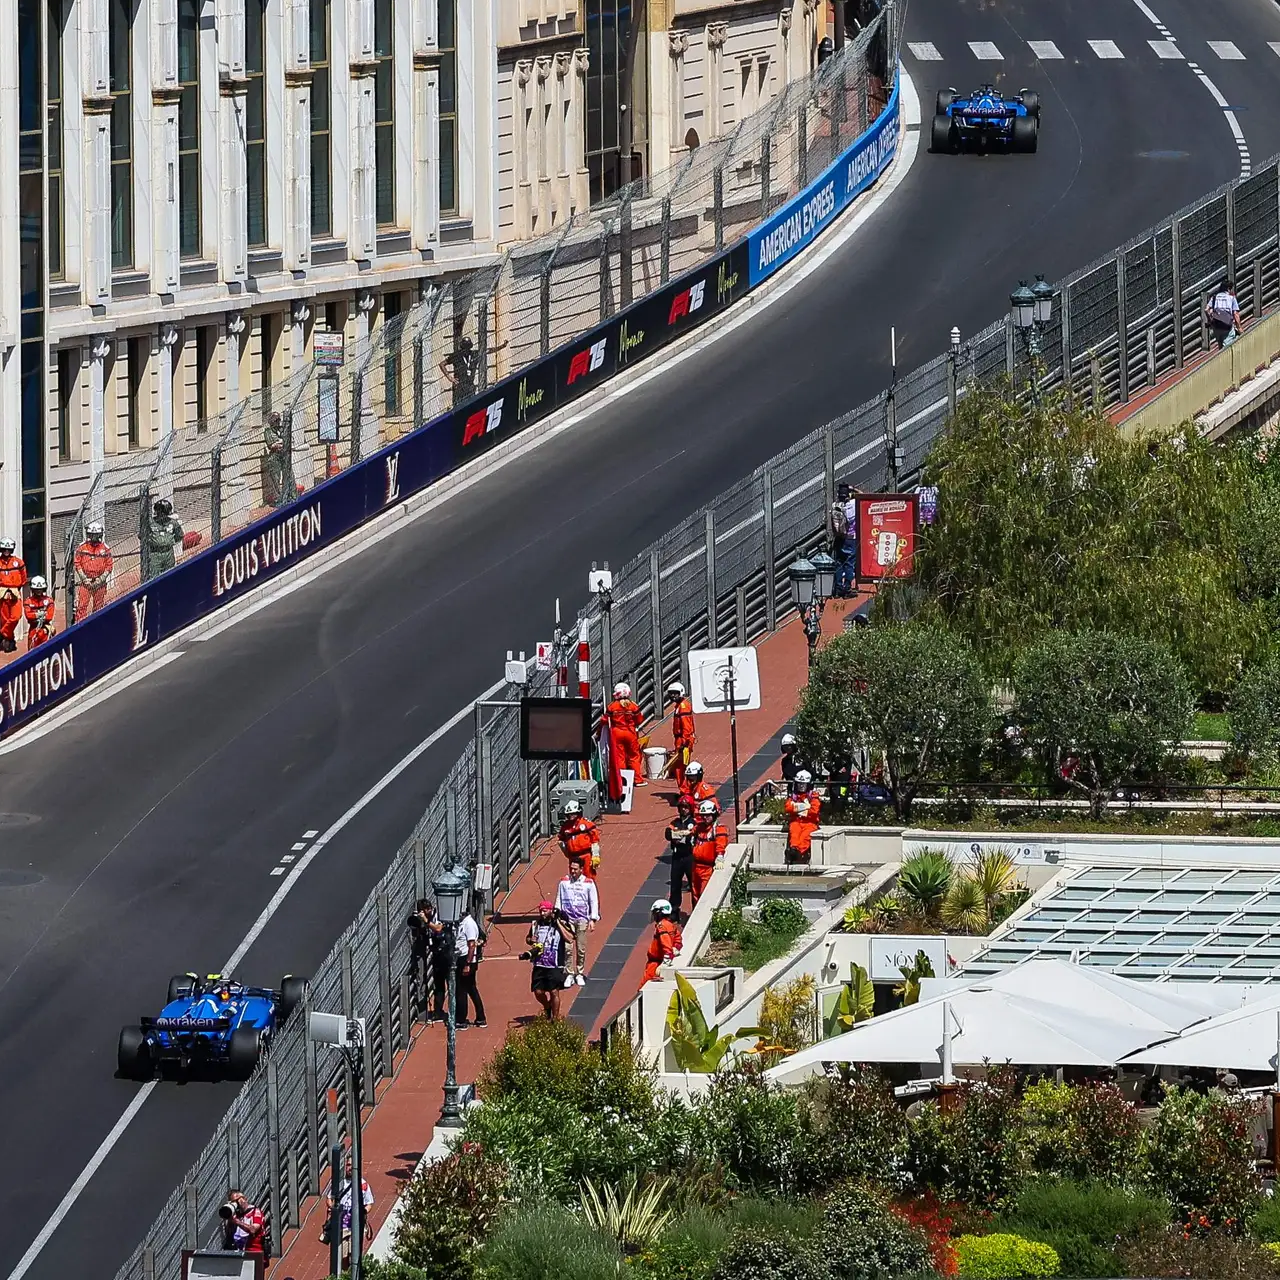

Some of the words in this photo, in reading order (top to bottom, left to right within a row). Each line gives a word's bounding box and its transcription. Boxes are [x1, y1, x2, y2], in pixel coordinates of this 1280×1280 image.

[847, 138, 878, 193] AMERICAN
[759, 210, 802, 271] AMERICAN
[802, 181, 835, 235] EXPRESS
[217, 539, 259, 596] LOUIS
[262, 502, 322, 568] VUITTON
[8, 643, 74, 716] VUITTON
[169, 1017, 214, 1027] kraken
